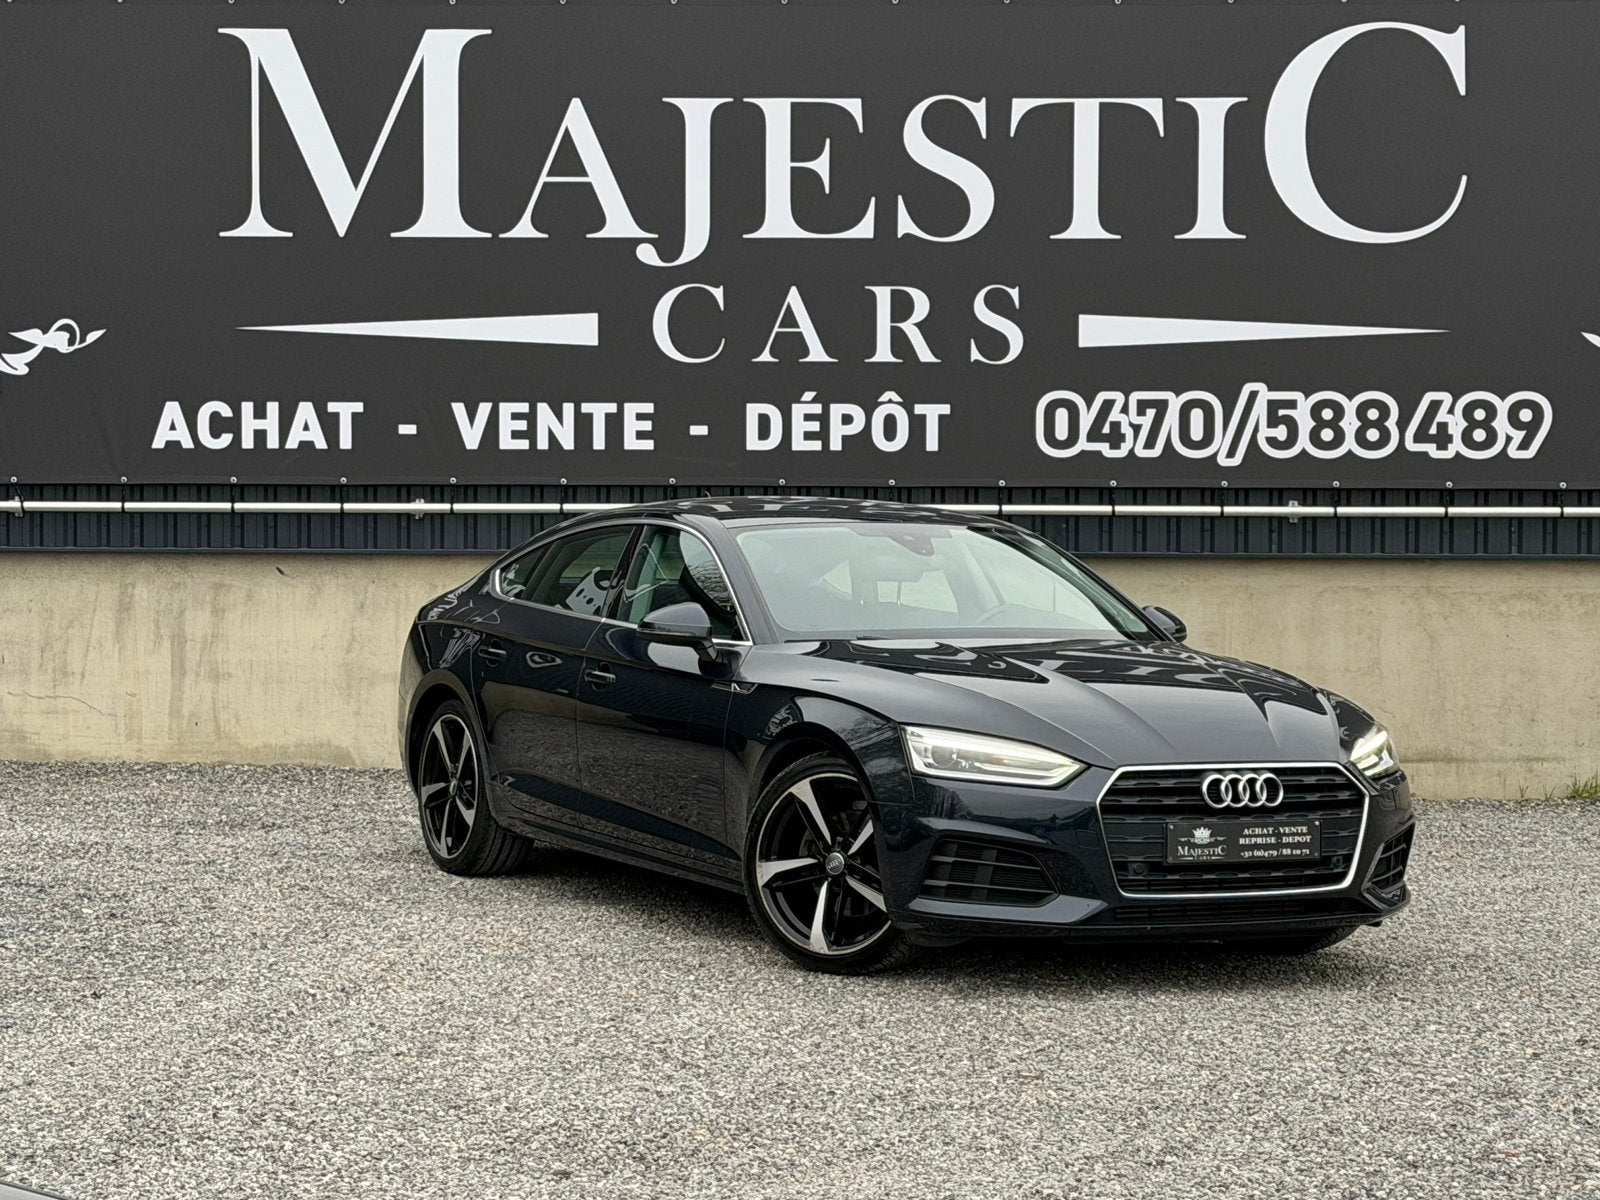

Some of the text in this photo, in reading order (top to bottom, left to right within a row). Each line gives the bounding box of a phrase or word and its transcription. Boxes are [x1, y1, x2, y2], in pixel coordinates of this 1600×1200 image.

[218, 22, 1467, 268] MAJESTIC
[652, 284, 1024, 365] CARS
[151, 391, 951, 453] ACHAT - VENTE - DÉPÔT
[1035, 382, 1553, 467] 0470/588 489
[1177, 844, 1228, 857] MAJESTIC
[1239, 837, 1277, 845] REPRISE
[1282, 835, 1312, 843] DEPOT
[1243, 827, 1274, 835] ACHAT
[1279, 826, 1308, 834] VENTE
